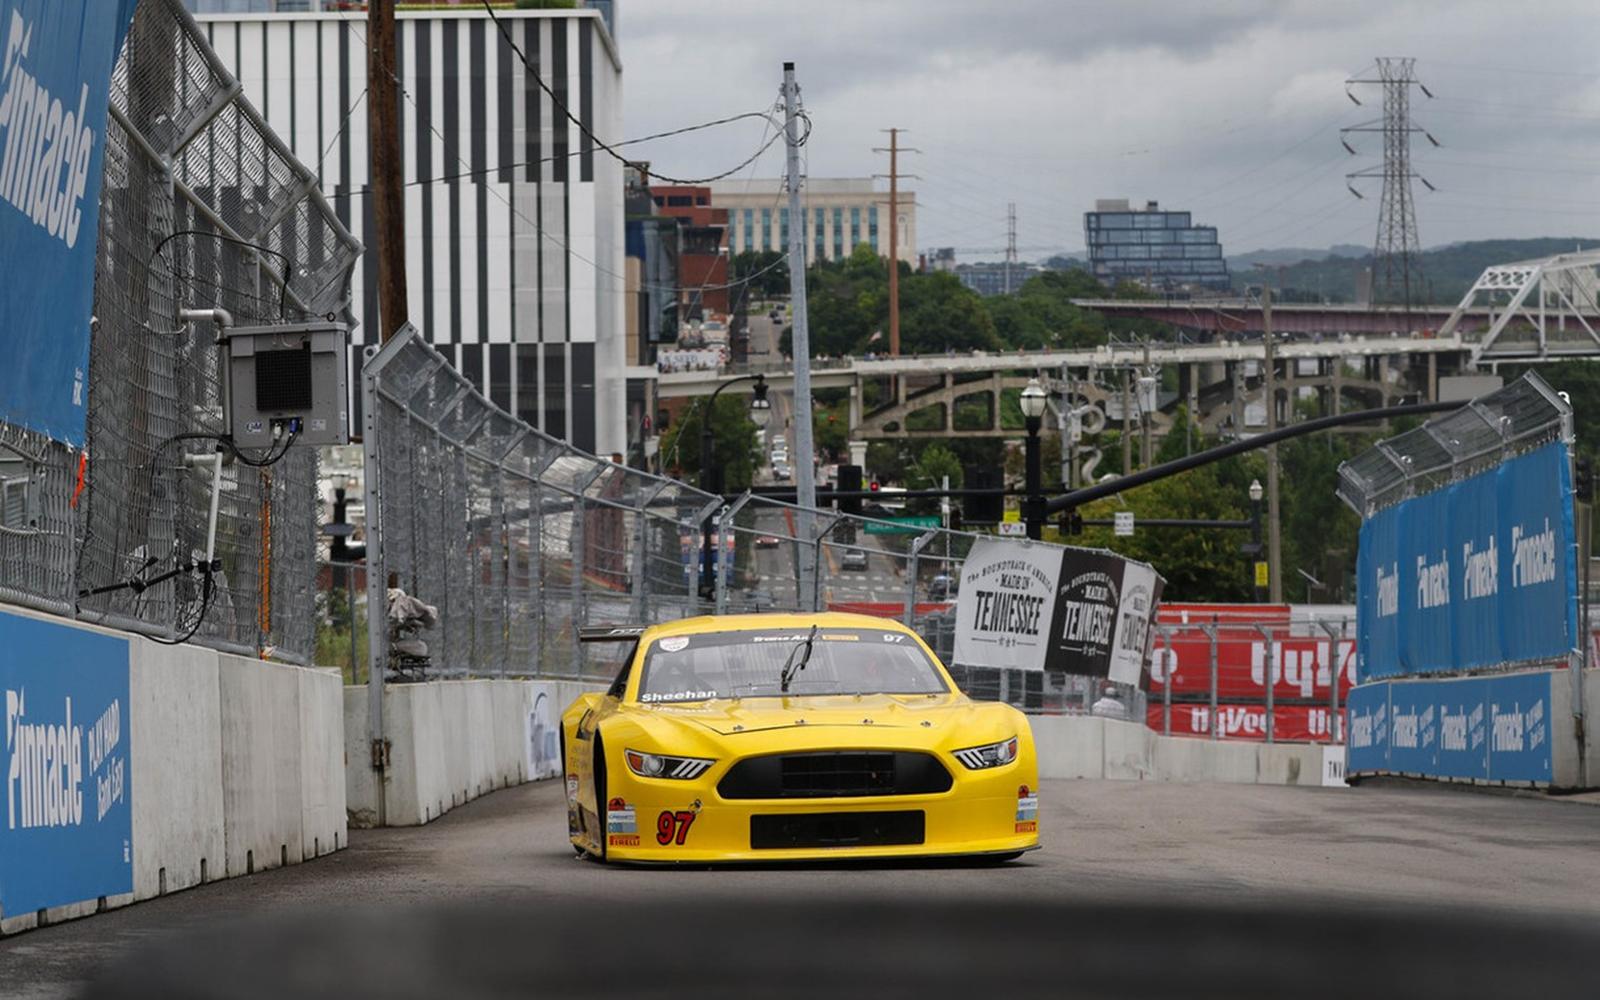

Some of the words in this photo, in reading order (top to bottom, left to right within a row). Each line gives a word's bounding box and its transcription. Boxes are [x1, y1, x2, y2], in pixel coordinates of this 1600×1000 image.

[0, 8, 92, 249] Pinnacle
[1512, 517, 1555, 587] Pinnacle
[974, 590, 1044, 635] TENNESSEE
[883, 634, 905, 643] 97
[642, 690, 717, 702] Sheehan
[6, 685, 83, 829] Pinnacle
[609, 835, 640, 846] PIRELLI
[657, 811, 696, 845] 97
